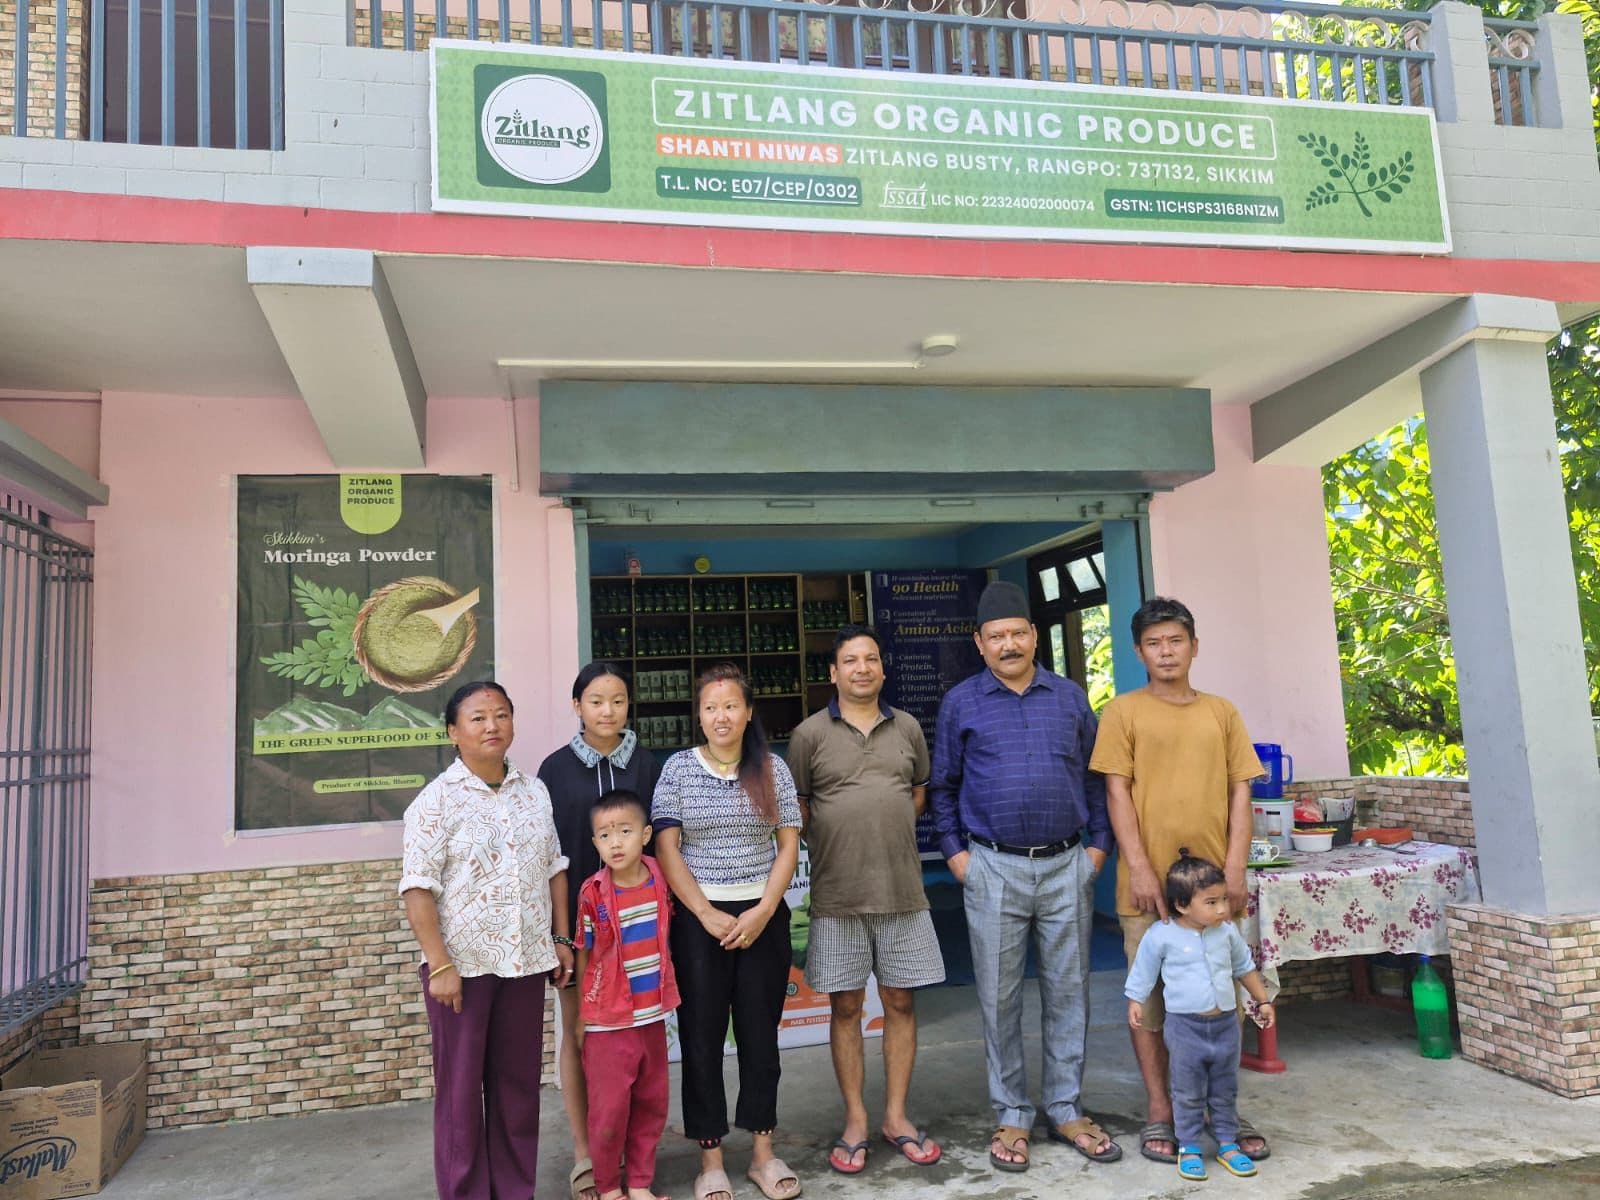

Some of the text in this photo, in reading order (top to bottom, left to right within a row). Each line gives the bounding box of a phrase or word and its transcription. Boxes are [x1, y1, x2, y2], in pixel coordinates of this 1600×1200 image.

[673, 88, 1256, 150] ZITLANG ORGANIC PRODUCE
[495, 115, 591, 149] Zitlang
[497, 138, 559, 148] ORGANIC PRODUCE
[660, 136, 1274, 184] SHANTI NIWAS ZITLANG BUSTY, RANGPO: 737132, SIKKIM
[661, 174, 858, 200] T.L. NO: E07/CEP/0302
[931, 194, 952, 206] LIC
[955, 195, 979, 208] NO:
[982, 196, 1095, 211] 22324002000074
[1110, 198, 1153, 213] GSTN:
[349, 478, 393, 486] ZITLANG
[347, 497, 395, 505] PRODUCE
[264, 547, 437, 566] Moringa Powder
[892, 581, 959, 595] 90 Health
[894, 623, 940, 636] Amino
[900, 672, 936, 682] Vitamin
[260, 739, 285, 749] THE
[289, 736, 333, 748] GREEN
[336, 732, 411, 746] SUPERFOOD
[414, 732, 431, 741] OF
[321, 782, 352, 790] Product
